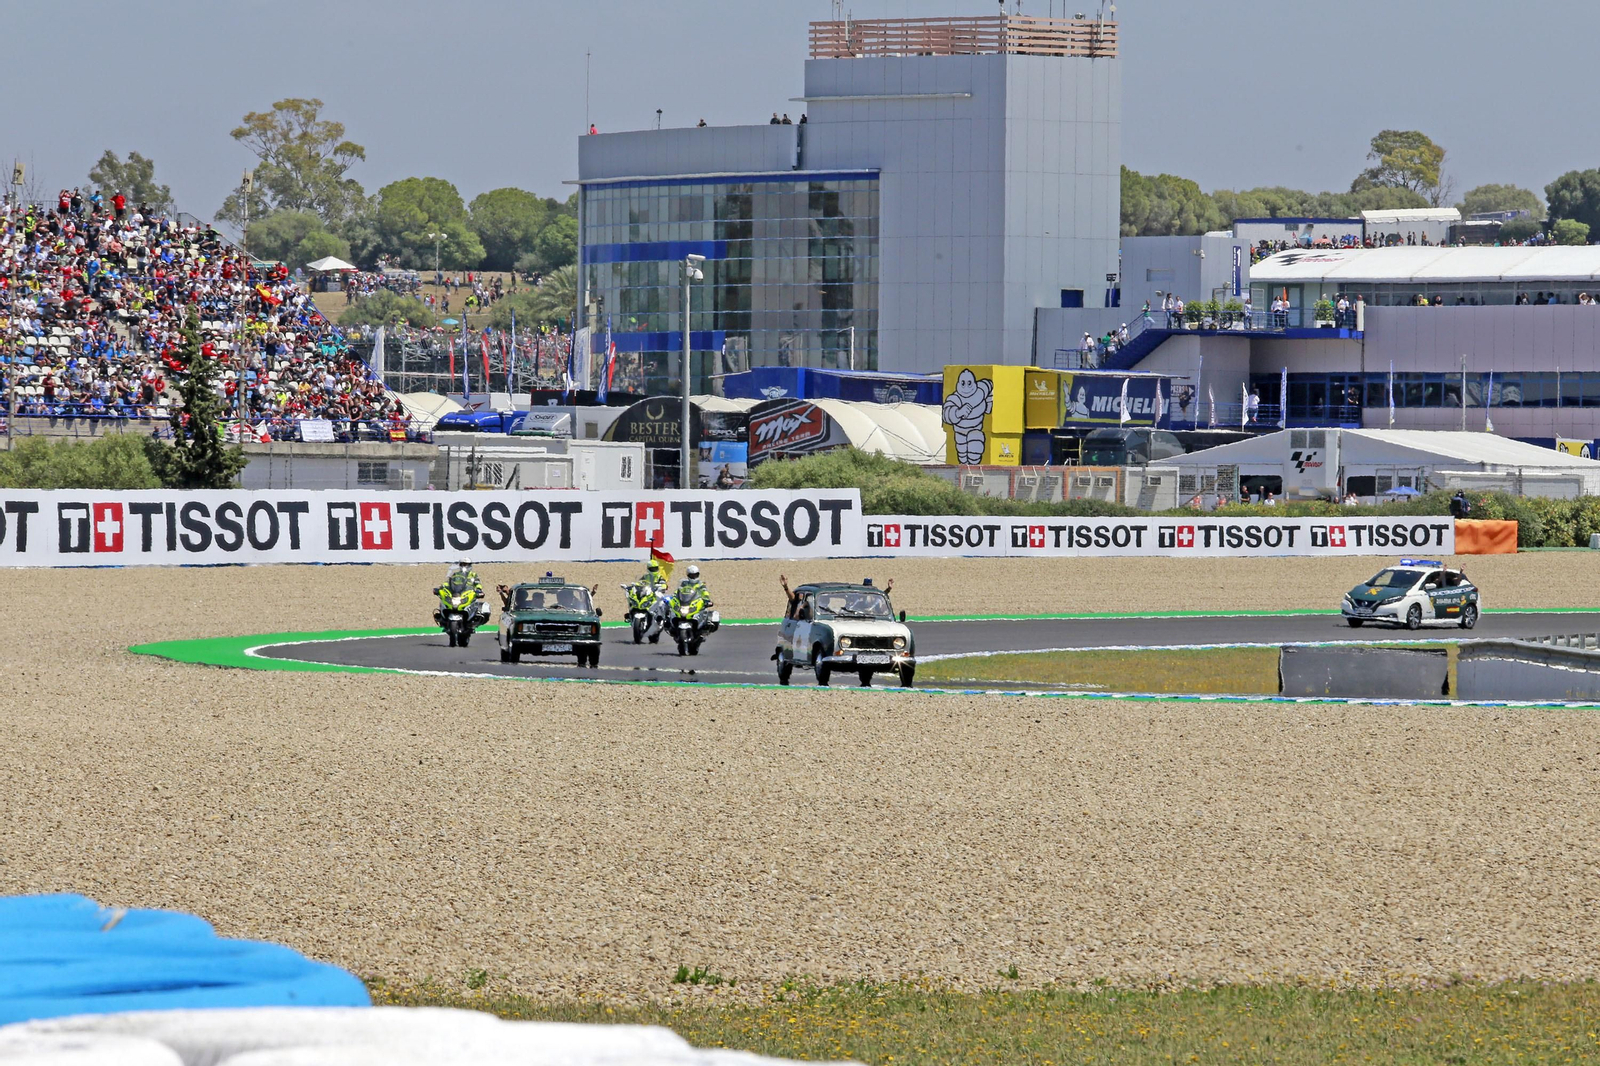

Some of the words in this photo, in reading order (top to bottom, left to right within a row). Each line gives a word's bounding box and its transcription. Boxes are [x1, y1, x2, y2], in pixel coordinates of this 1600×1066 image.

[630, 422, 680, 435] BESTER
[128, 500, 309, 552] TISSOT
[397, 500, 582, 550] TISSOT
[671, 499, 852, 548] TISSOT
[905, 524, 1001, 547] TISSOT
[1048, 525, 1148, 548] TISSOT
[1198, 525, 1301, 548] TISSOT
[1349, 524, 1449, 547] TISSOT
